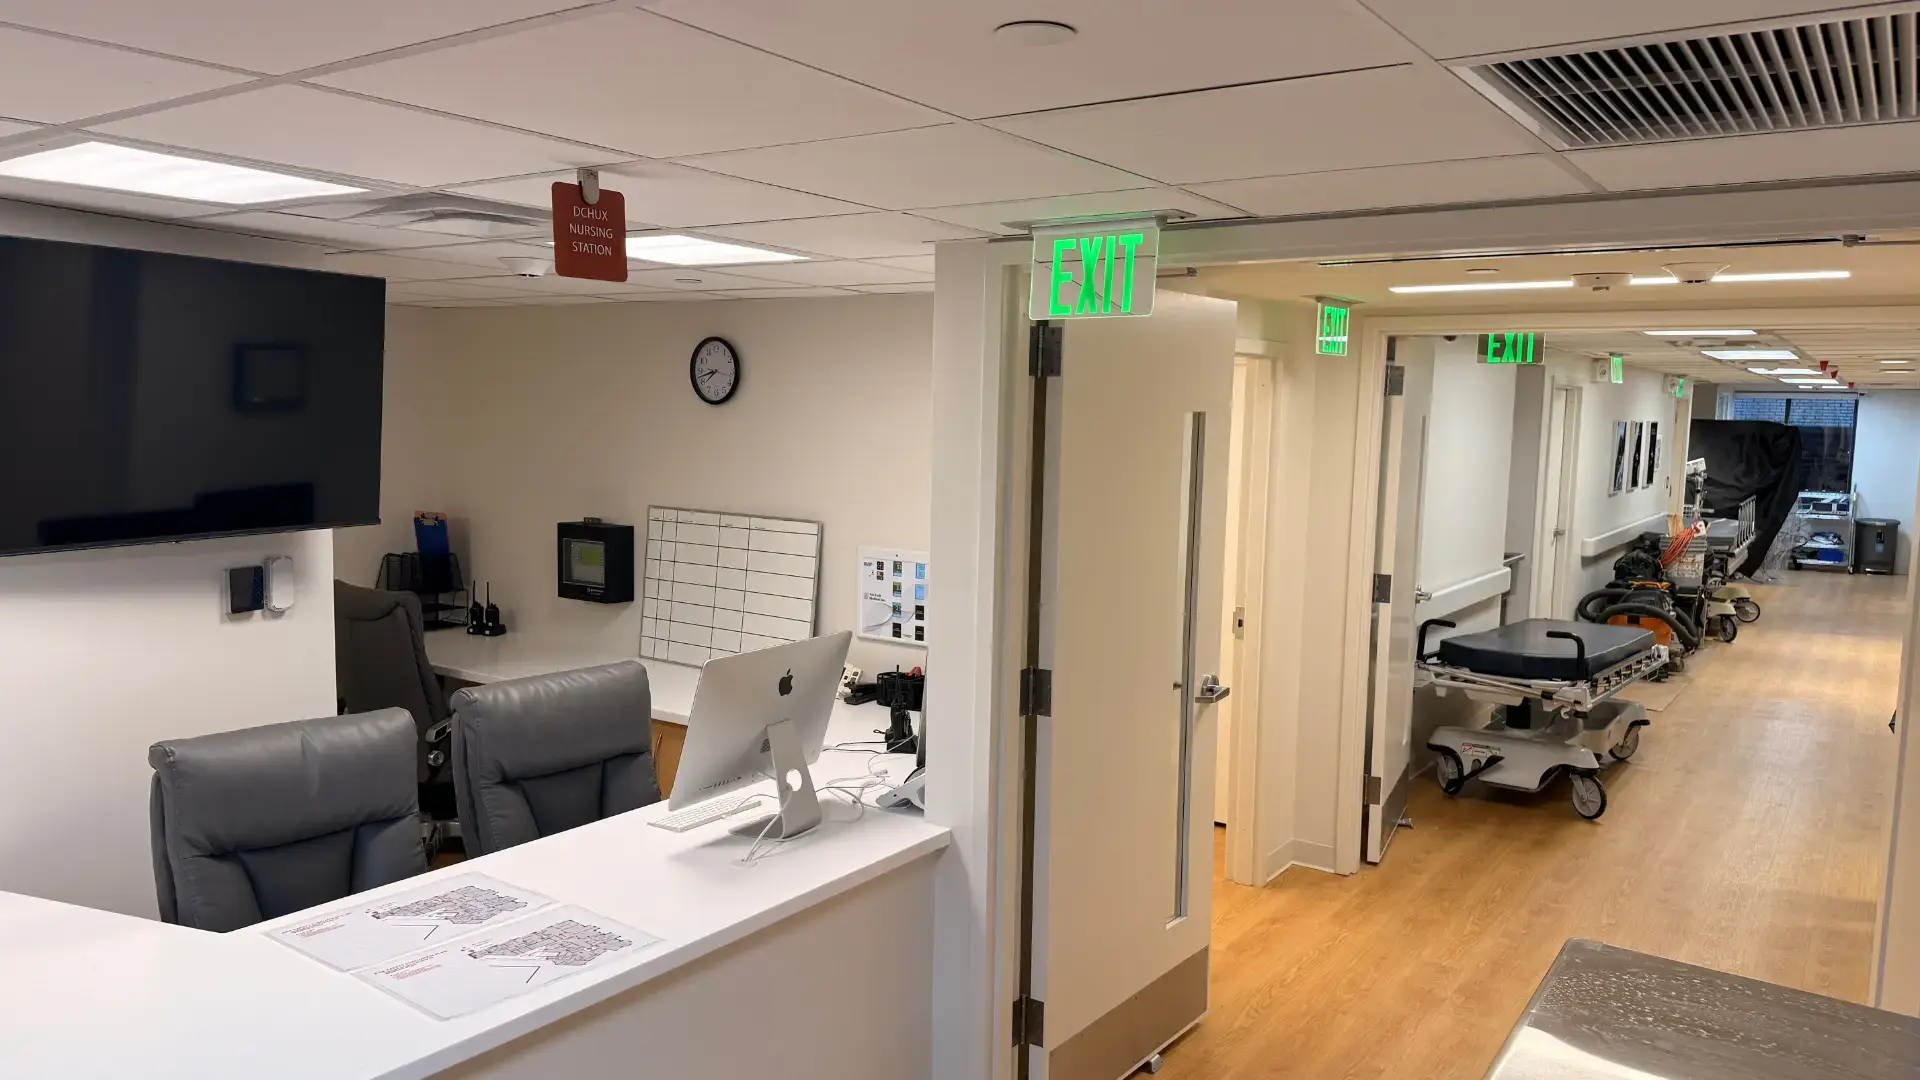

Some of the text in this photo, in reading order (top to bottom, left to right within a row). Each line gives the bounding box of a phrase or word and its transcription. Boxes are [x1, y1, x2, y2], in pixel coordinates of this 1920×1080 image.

[573, 205, 608, 221] DCHUX
[569, 223, 613, 239] NURSING
[572, 241, 612, 256] STATION
[1049, 233, 1144, 316] EXIT
[1323, 306, 1346, 353] EXIT
